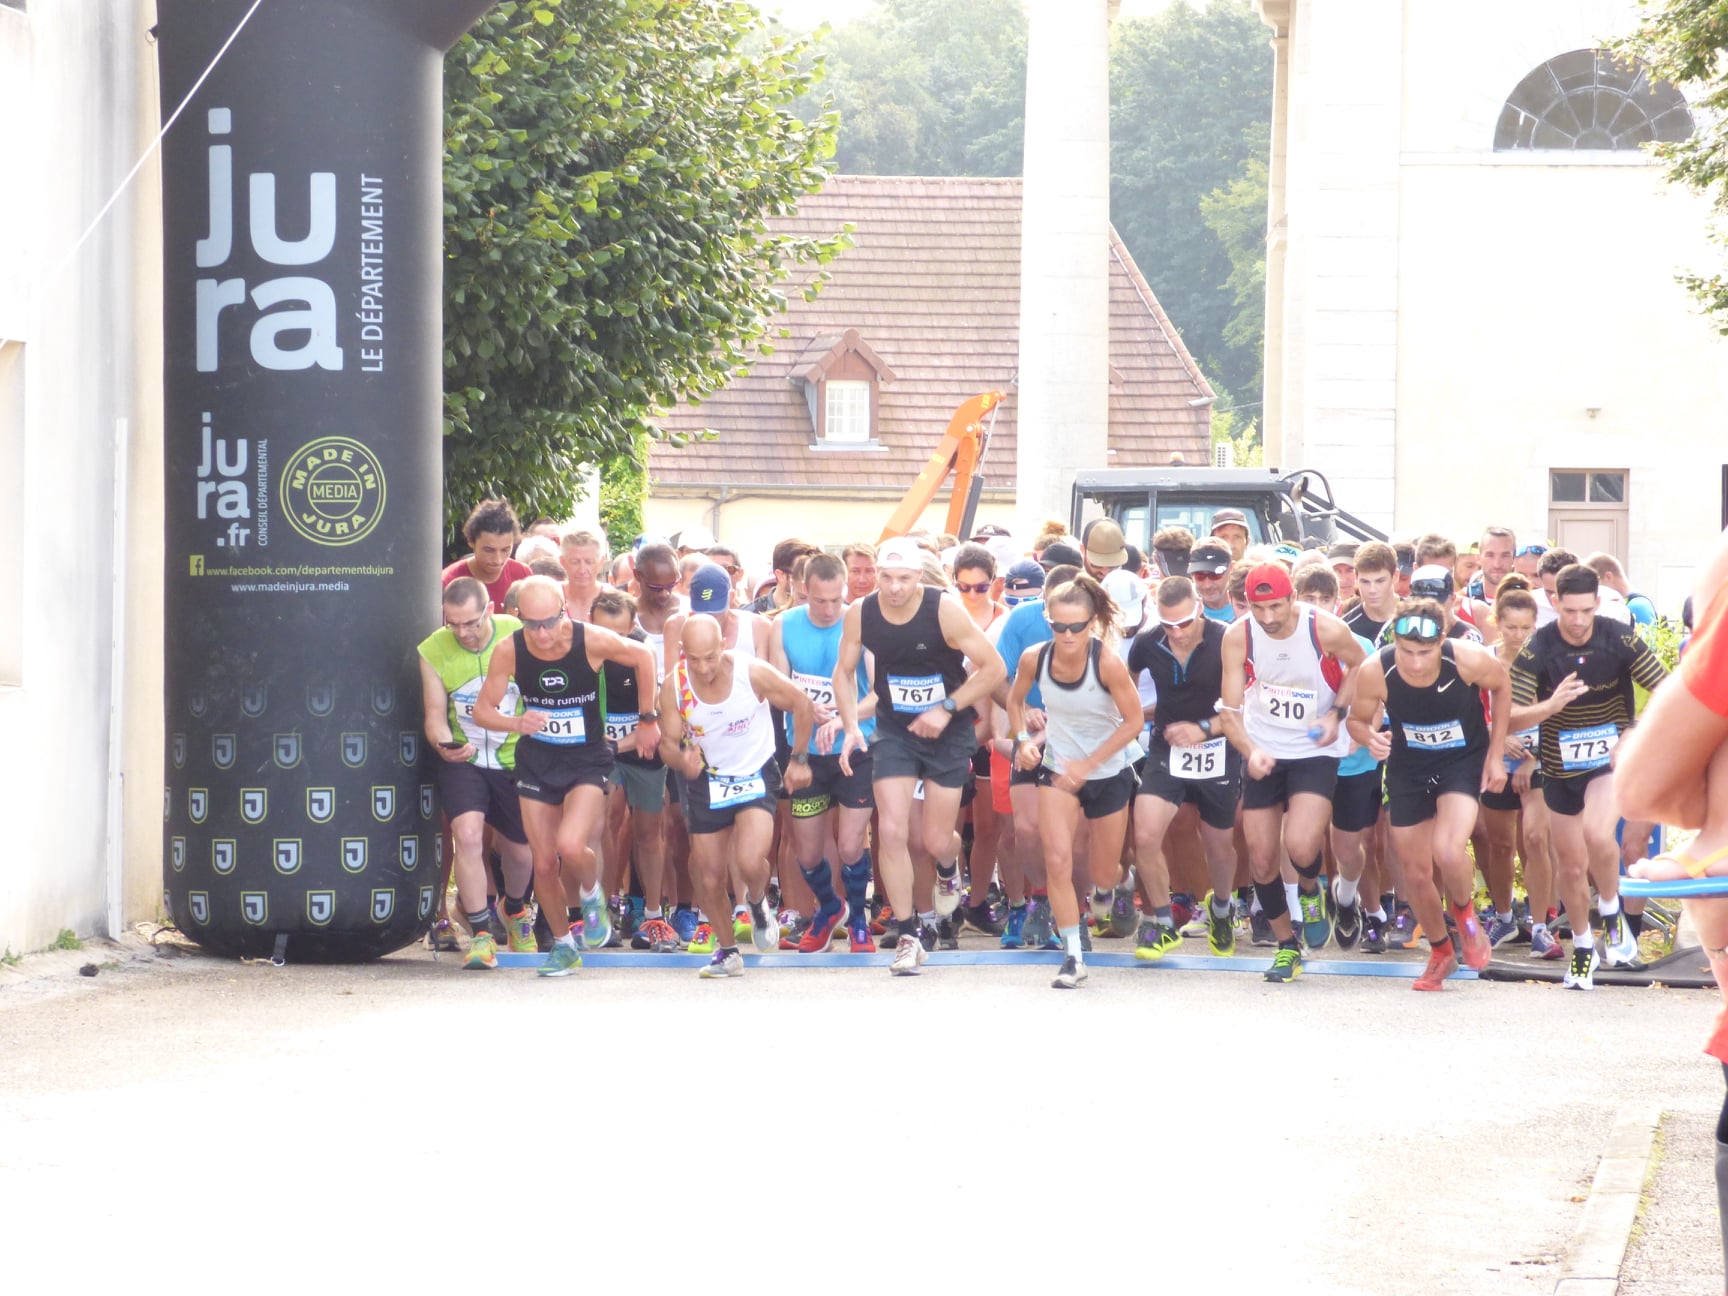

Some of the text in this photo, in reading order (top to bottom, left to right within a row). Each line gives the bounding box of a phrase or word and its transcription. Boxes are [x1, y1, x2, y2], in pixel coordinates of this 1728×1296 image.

[355, 173, 383, 371] LE DÉPARTEMENT
[292, 448, 376, 490] MADE IN
[256, 438, 268, 547] CONSEIL DÉPARTEMENTAL
[312, 484, 358, 499] MEDIA
[302, 513, 366, 535] JURA
[217, 523, 250, 546] .fr
[206, 565, 394, 576] www.facebook.com/departementdujura
[231, 581, 350, 593] www.madeinjura.media
[898, 687, 934, 703] 767
[1268, 686, 1315, 699] INTERSPORT
[1269, 697, 1305, 720] 210
[1414, 730, 1454, 744] 812
[1572, 727, 1614, 740] BROOKS
[1569, 739, 1610, 759] 773
[1181, 752, 1215, 773] 215
